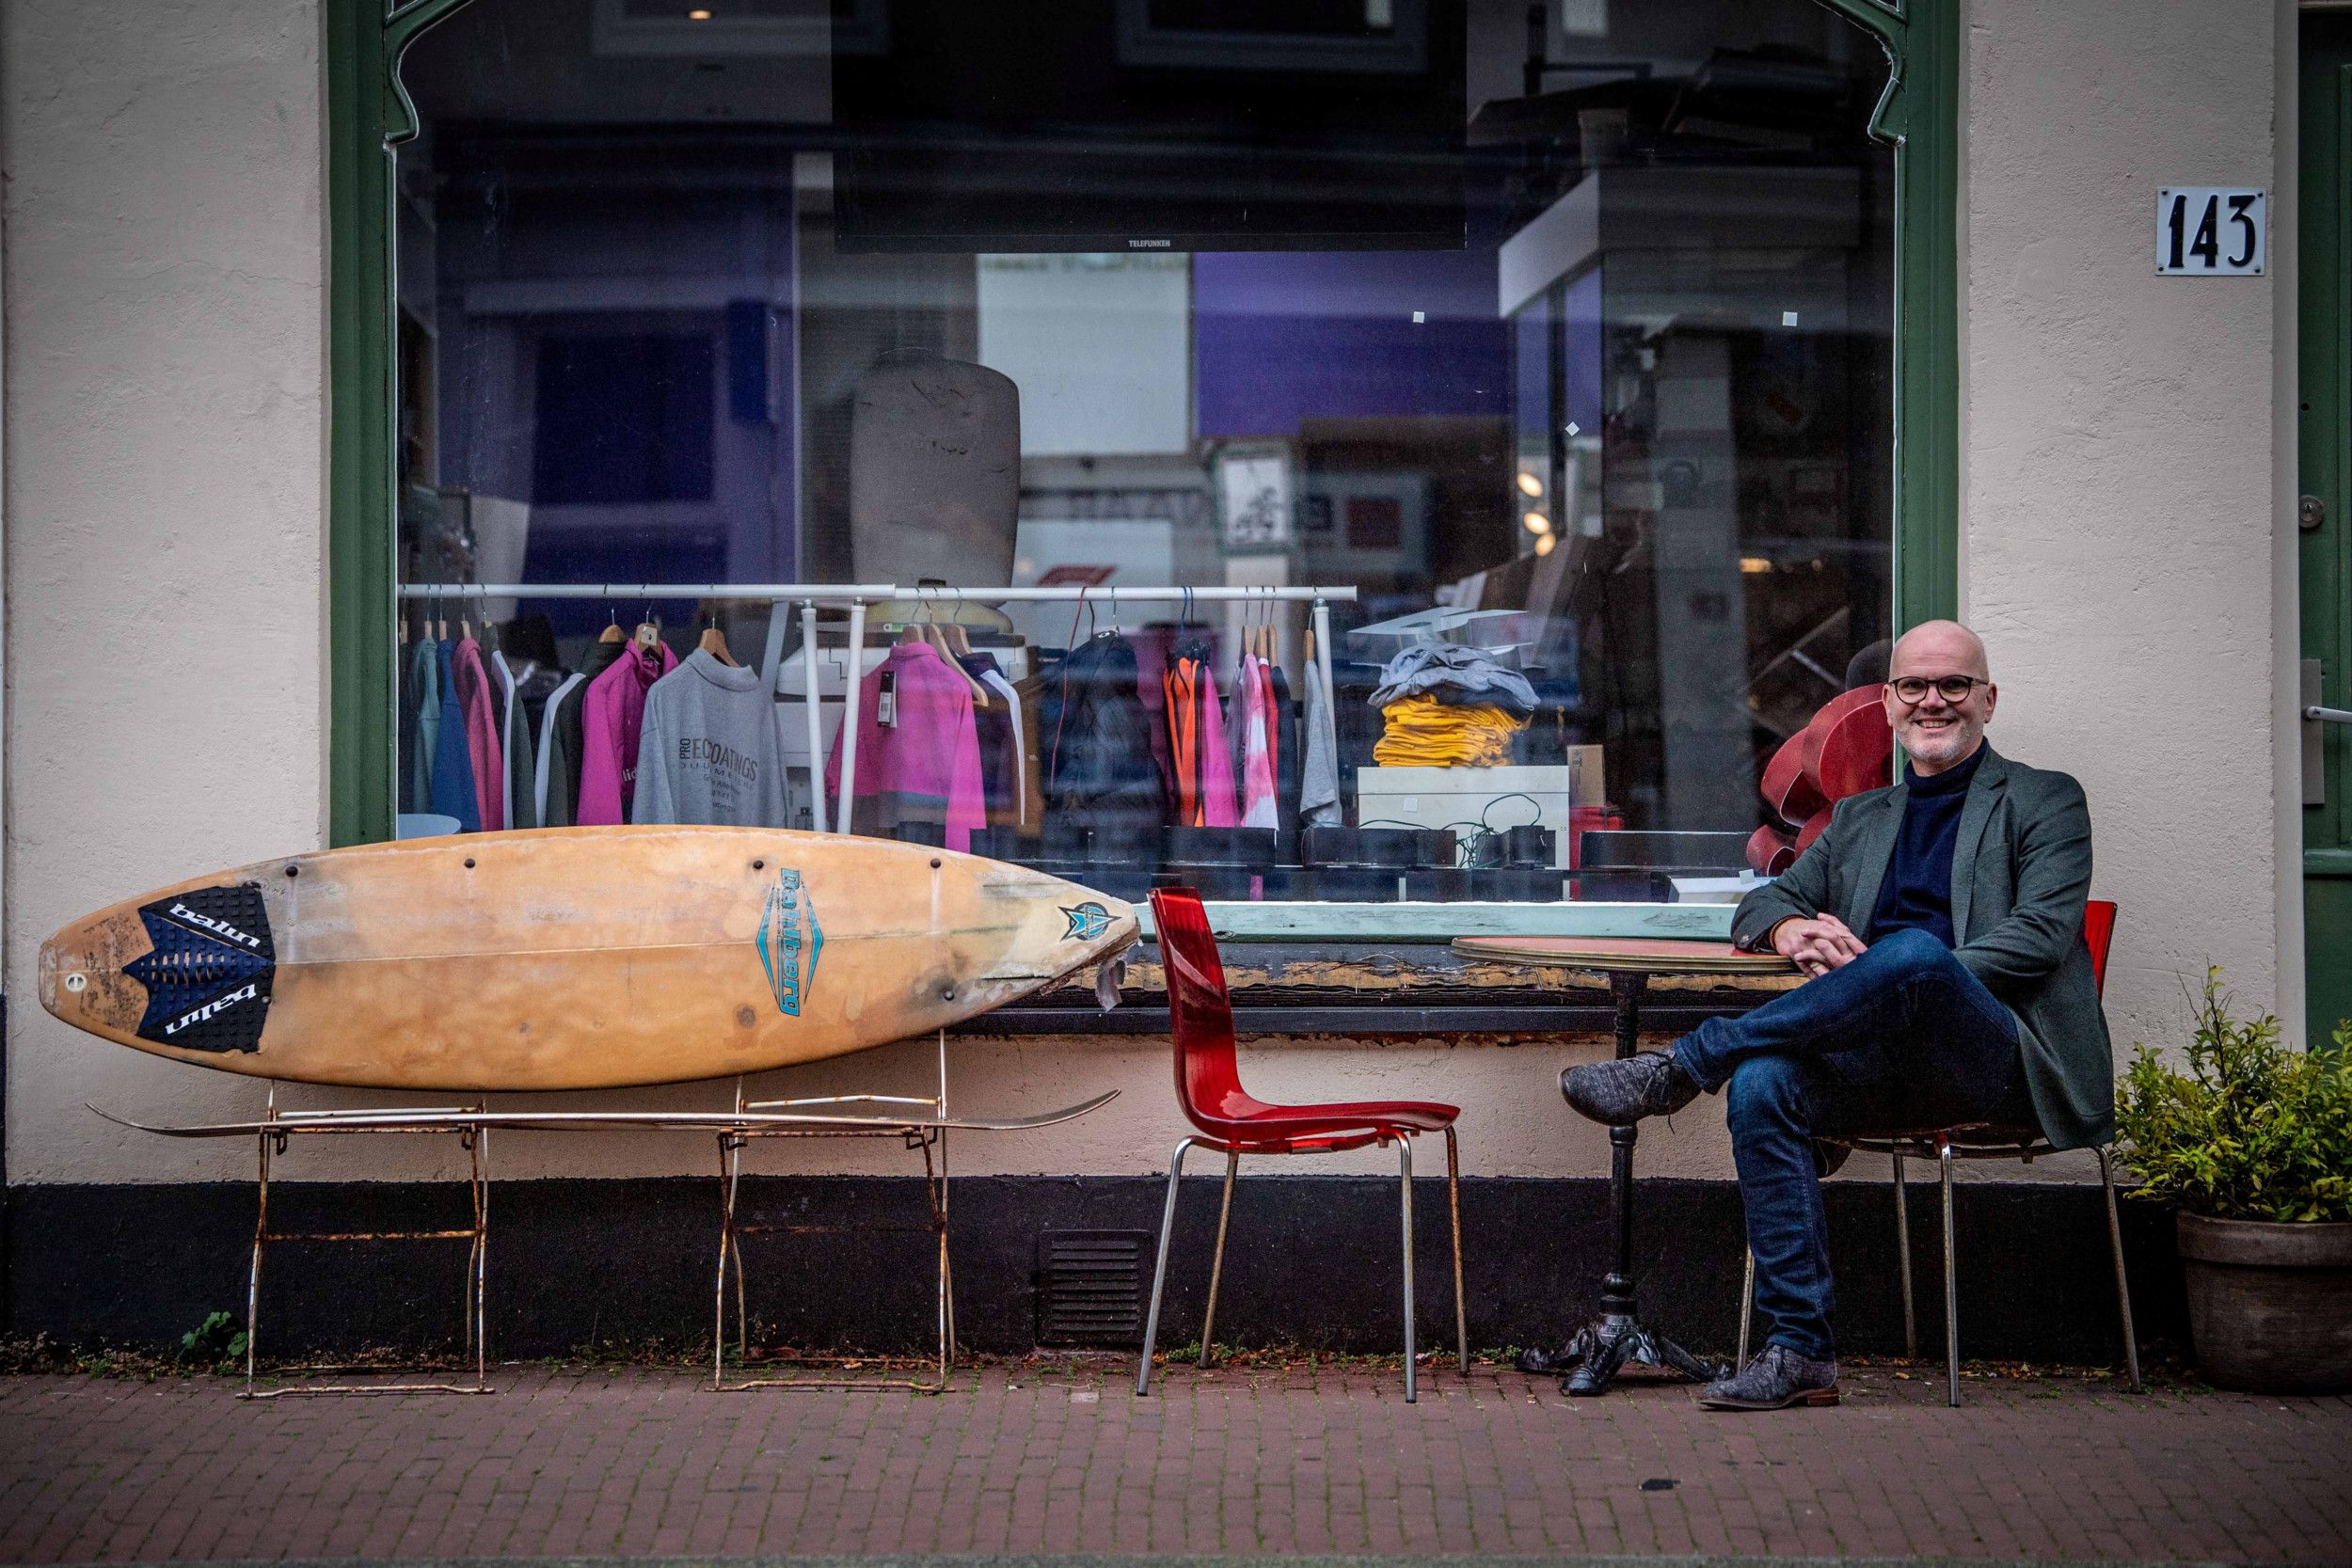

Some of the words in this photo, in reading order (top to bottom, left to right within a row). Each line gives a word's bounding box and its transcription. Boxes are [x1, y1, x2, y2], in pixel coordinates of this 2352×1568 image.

[1128, 239, 1171, 247] TELEFUNKEN
[2169, 194, 2256, 268] 143
[678, 737, 691, 760] PRO
[777, 867, 803, 1017] Dahlberg
